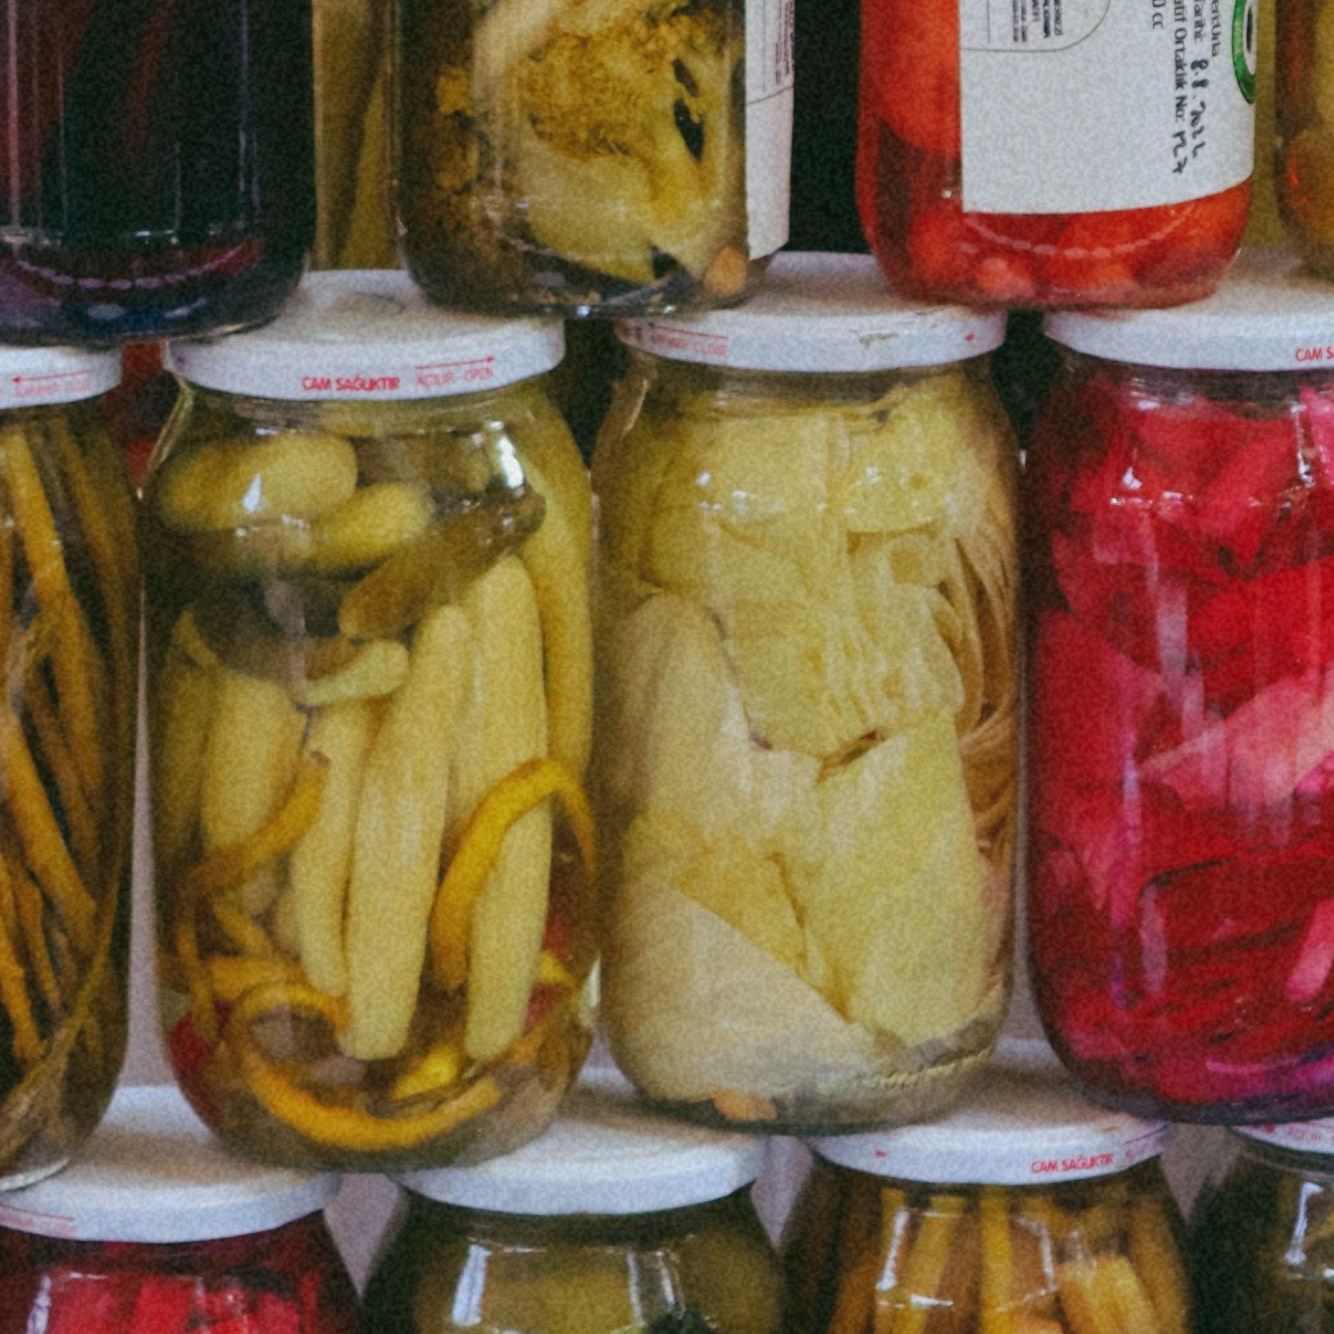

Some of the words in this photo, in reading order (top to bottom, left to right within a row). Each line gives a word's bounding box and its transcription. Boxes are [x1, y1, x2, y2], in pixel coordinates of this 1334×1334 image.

[1152, 12, 1164, 30] cc
[1173, 27, 1188, 91] Ortaklık
[1174, 95, 1188, 123] No:
[1294, 345, 1324, 363] CAM
[302, 375, 332, 392] CAM
[1031, 1160, 1058, 1174] CAM
